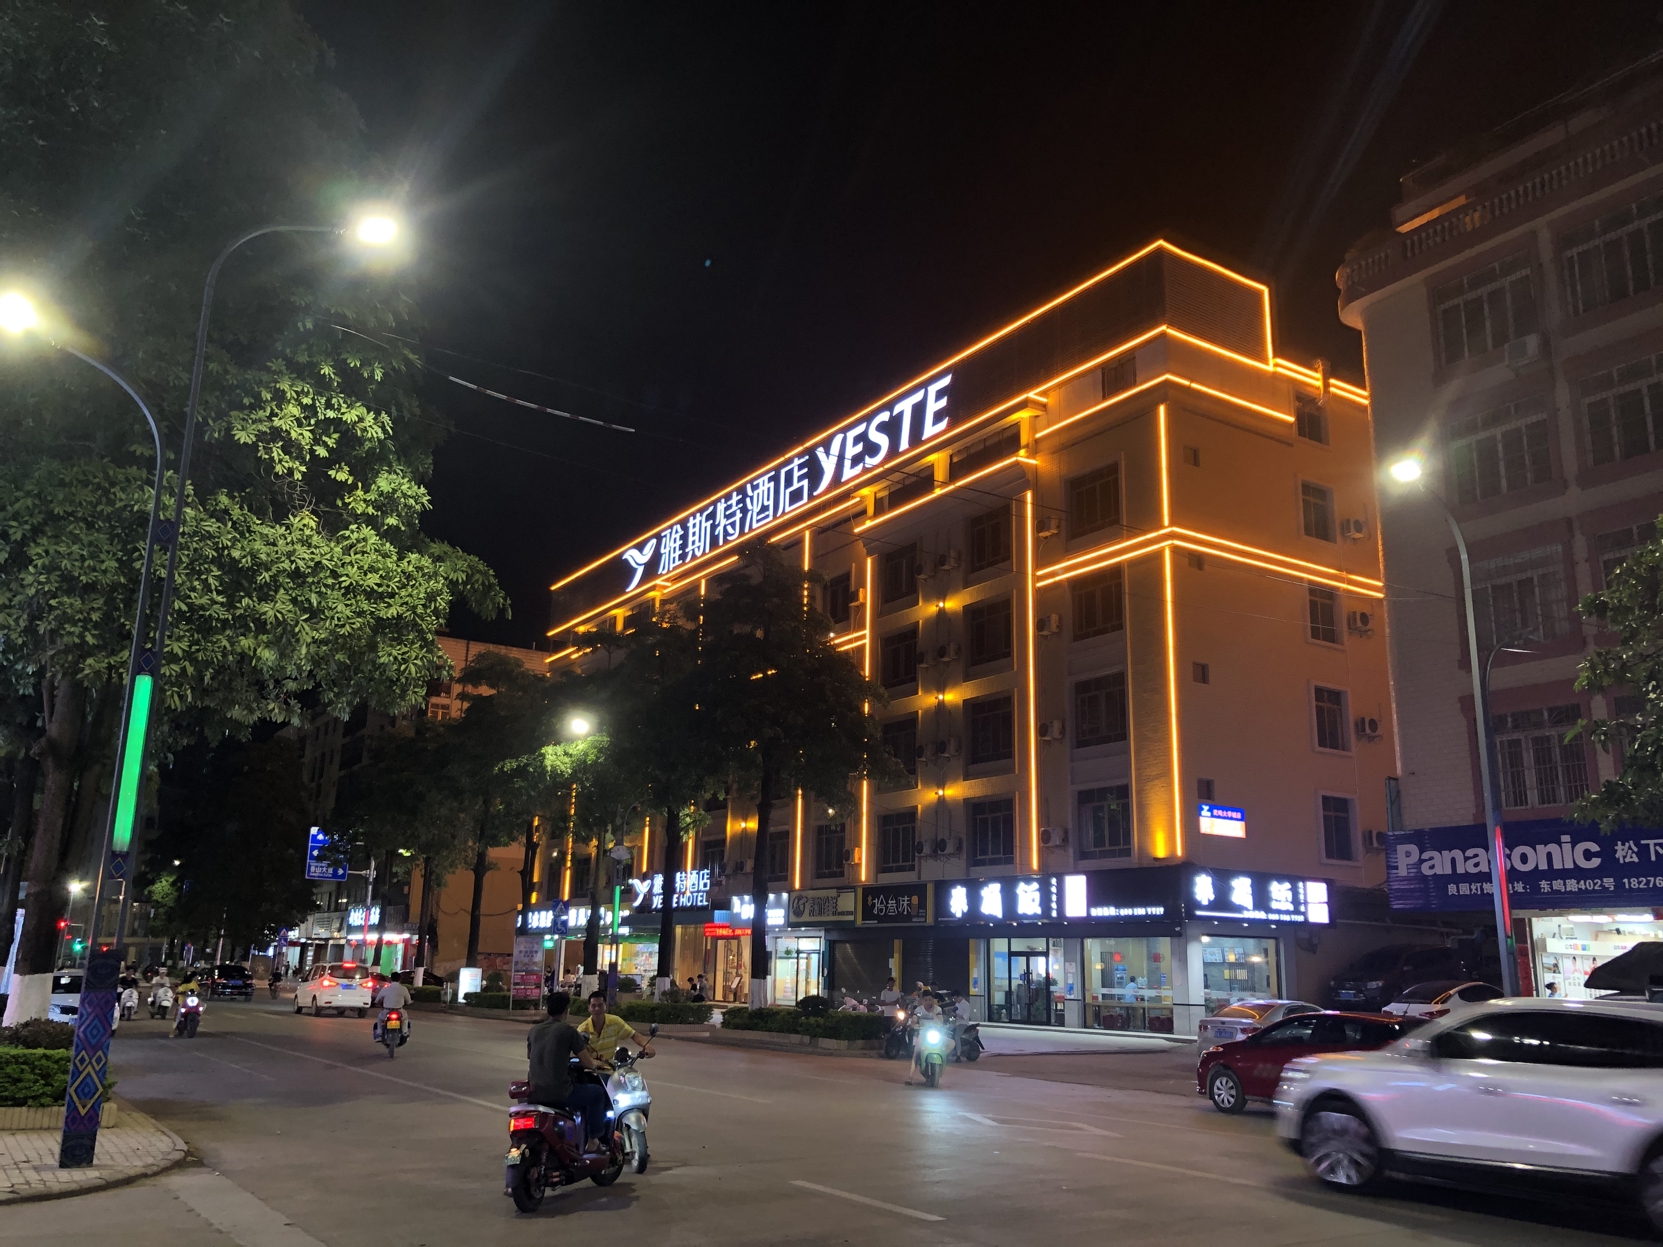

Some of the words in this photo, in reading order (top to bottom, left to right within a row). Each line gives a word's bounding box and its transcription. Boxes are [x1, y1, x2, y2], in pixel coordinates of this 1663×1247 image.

[813, 373, 953, 496] YESTE
[657, 455, 810, 575] 雅斯特酒店
[1615, 837, 1663, 864] 松下
[652, 869, 710, 894] 雅特酒店
[1538, 877, 1616, 893] 东鸣路402号
[1622, 876, 1663, 890] 18276
[652, 894, 679, 909] YEE
[679, 892, 709, 906] HOTEL
[872, 894, 912, 916] 拾叁味
